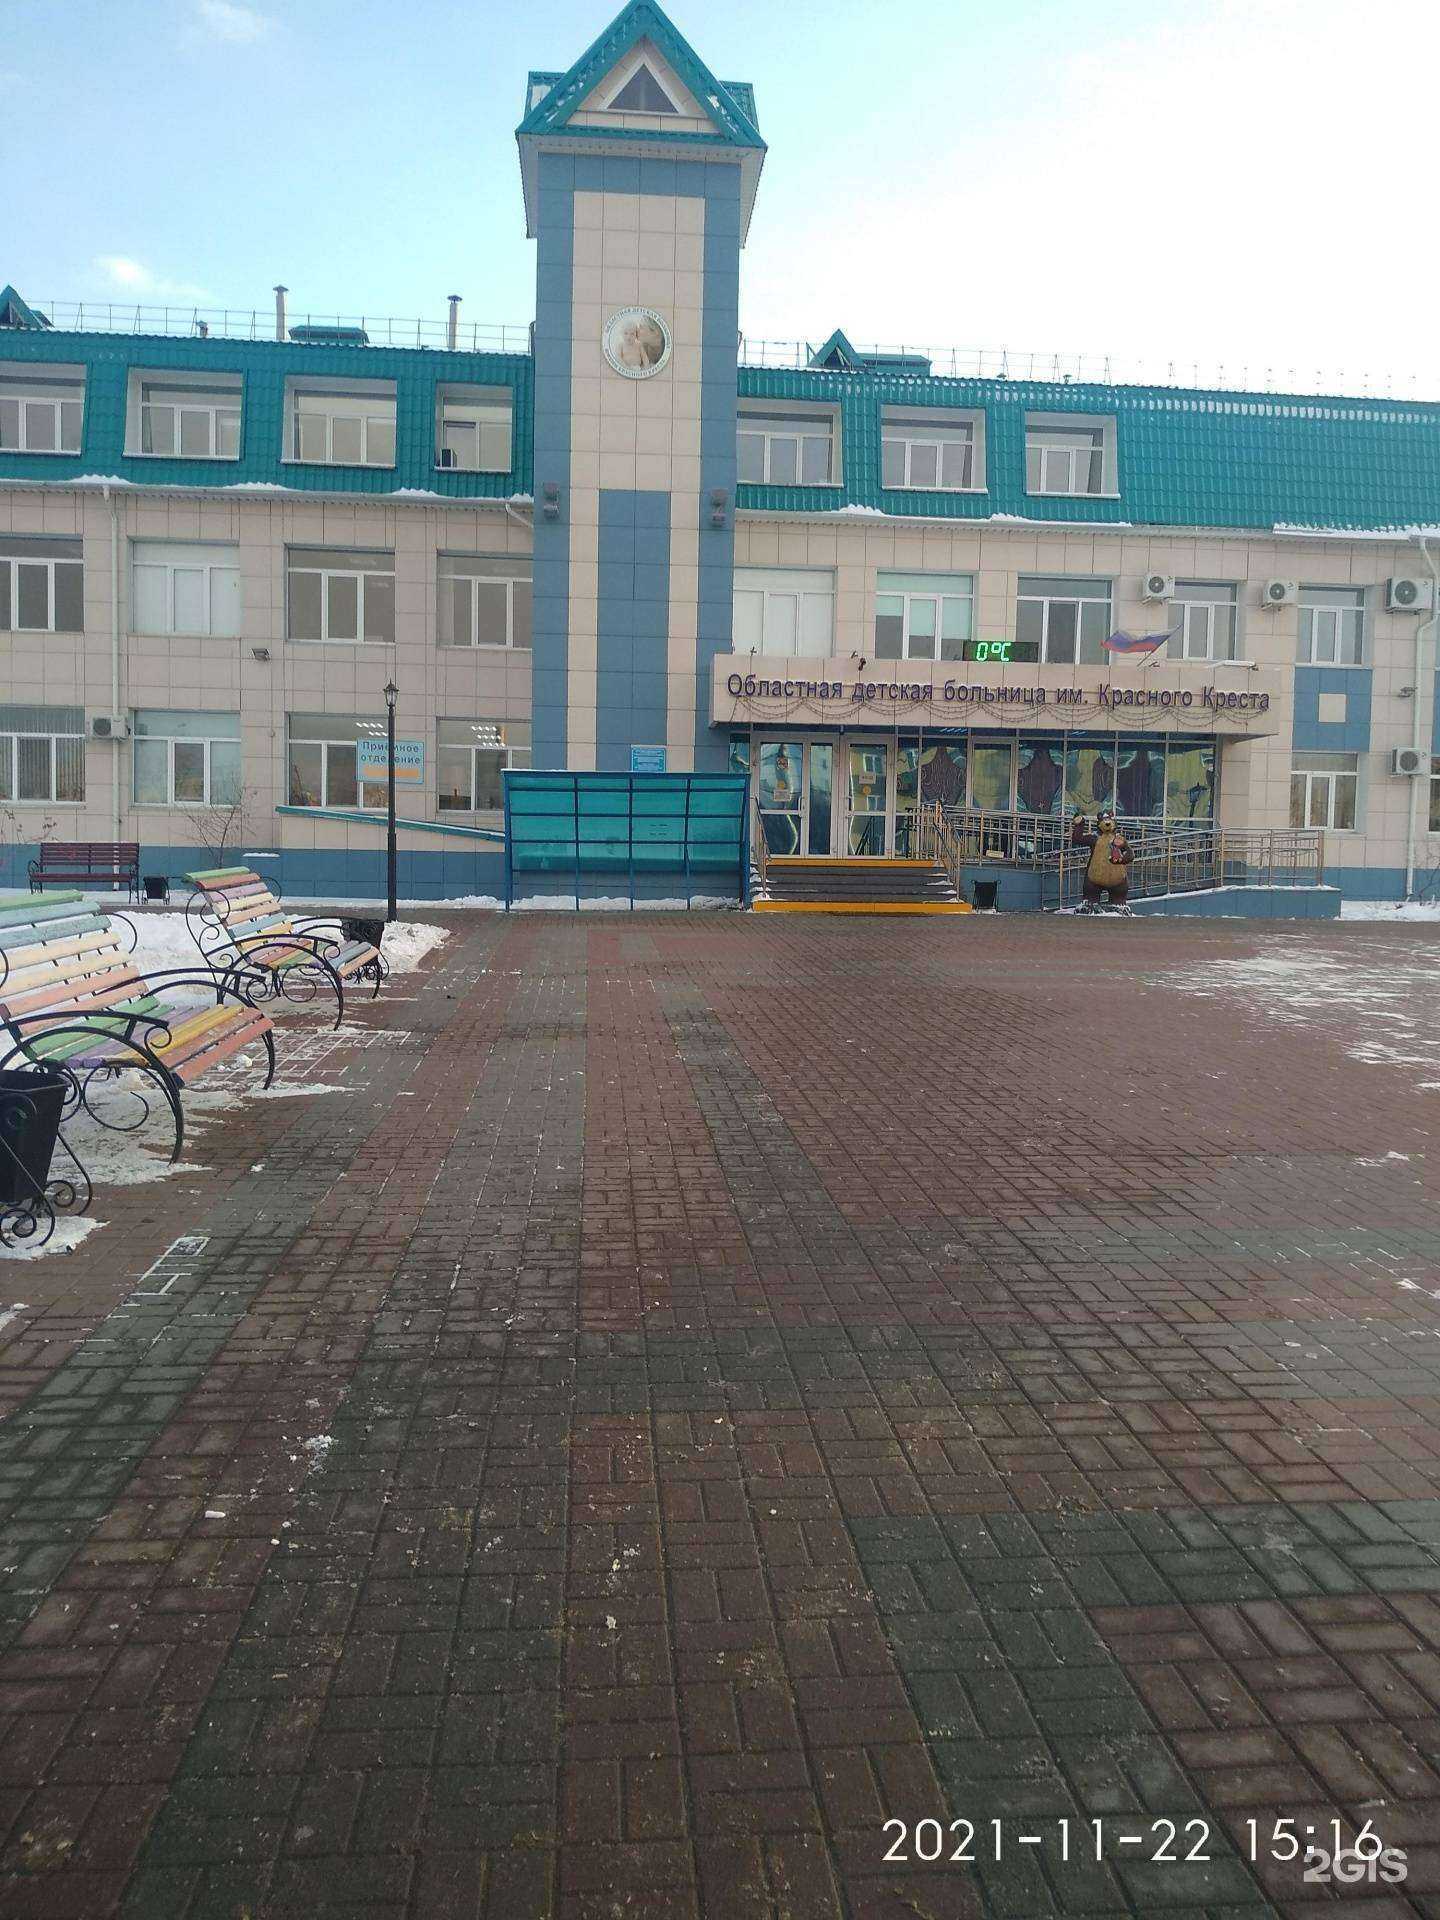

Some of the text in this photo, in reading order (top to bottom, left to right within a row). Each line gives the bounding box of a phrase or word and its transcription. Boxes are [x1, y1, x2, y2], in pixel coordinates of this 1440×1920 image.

[727, 673, 1270, 712] Областная детская больница им. Красного Креста
[360, 754, 421, 764] отдеение
